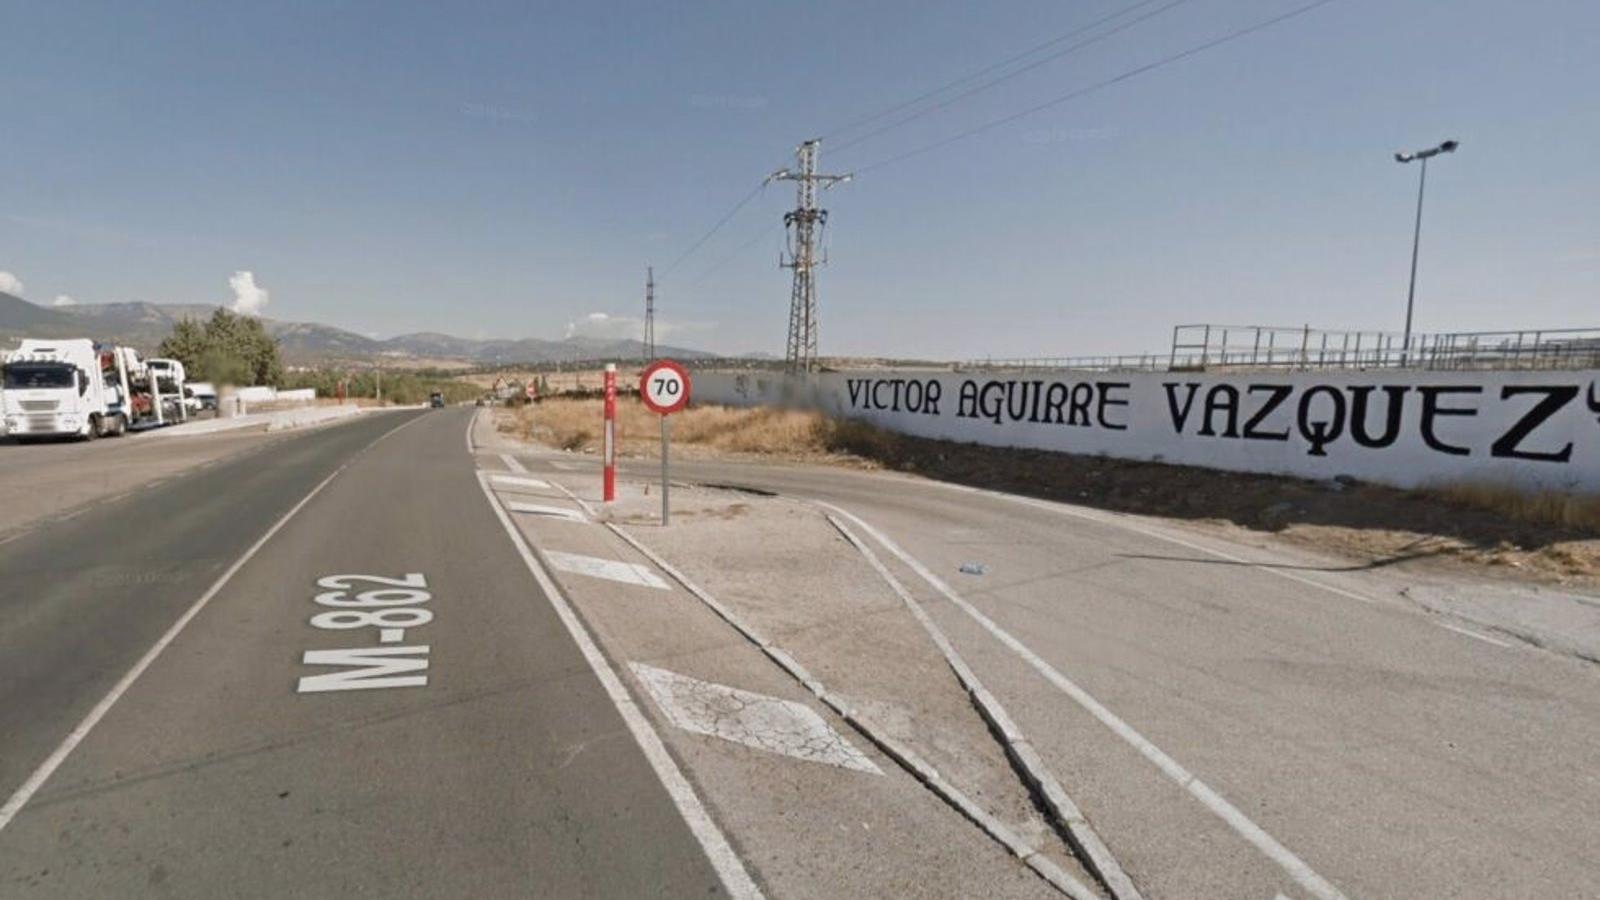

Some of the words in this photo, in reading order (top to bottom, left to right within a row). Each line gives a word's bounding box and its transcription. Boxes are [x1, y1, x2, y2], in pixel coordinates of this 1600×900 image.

[653, 378, 679, 396] 70
[848, 379, 942, 415] VICTOR
[956, 380, 1131, 431] AGUIRRE
[1162, 382, 1581, 463] VAZQUEZ
[297, 572, 434, 693] M-862
